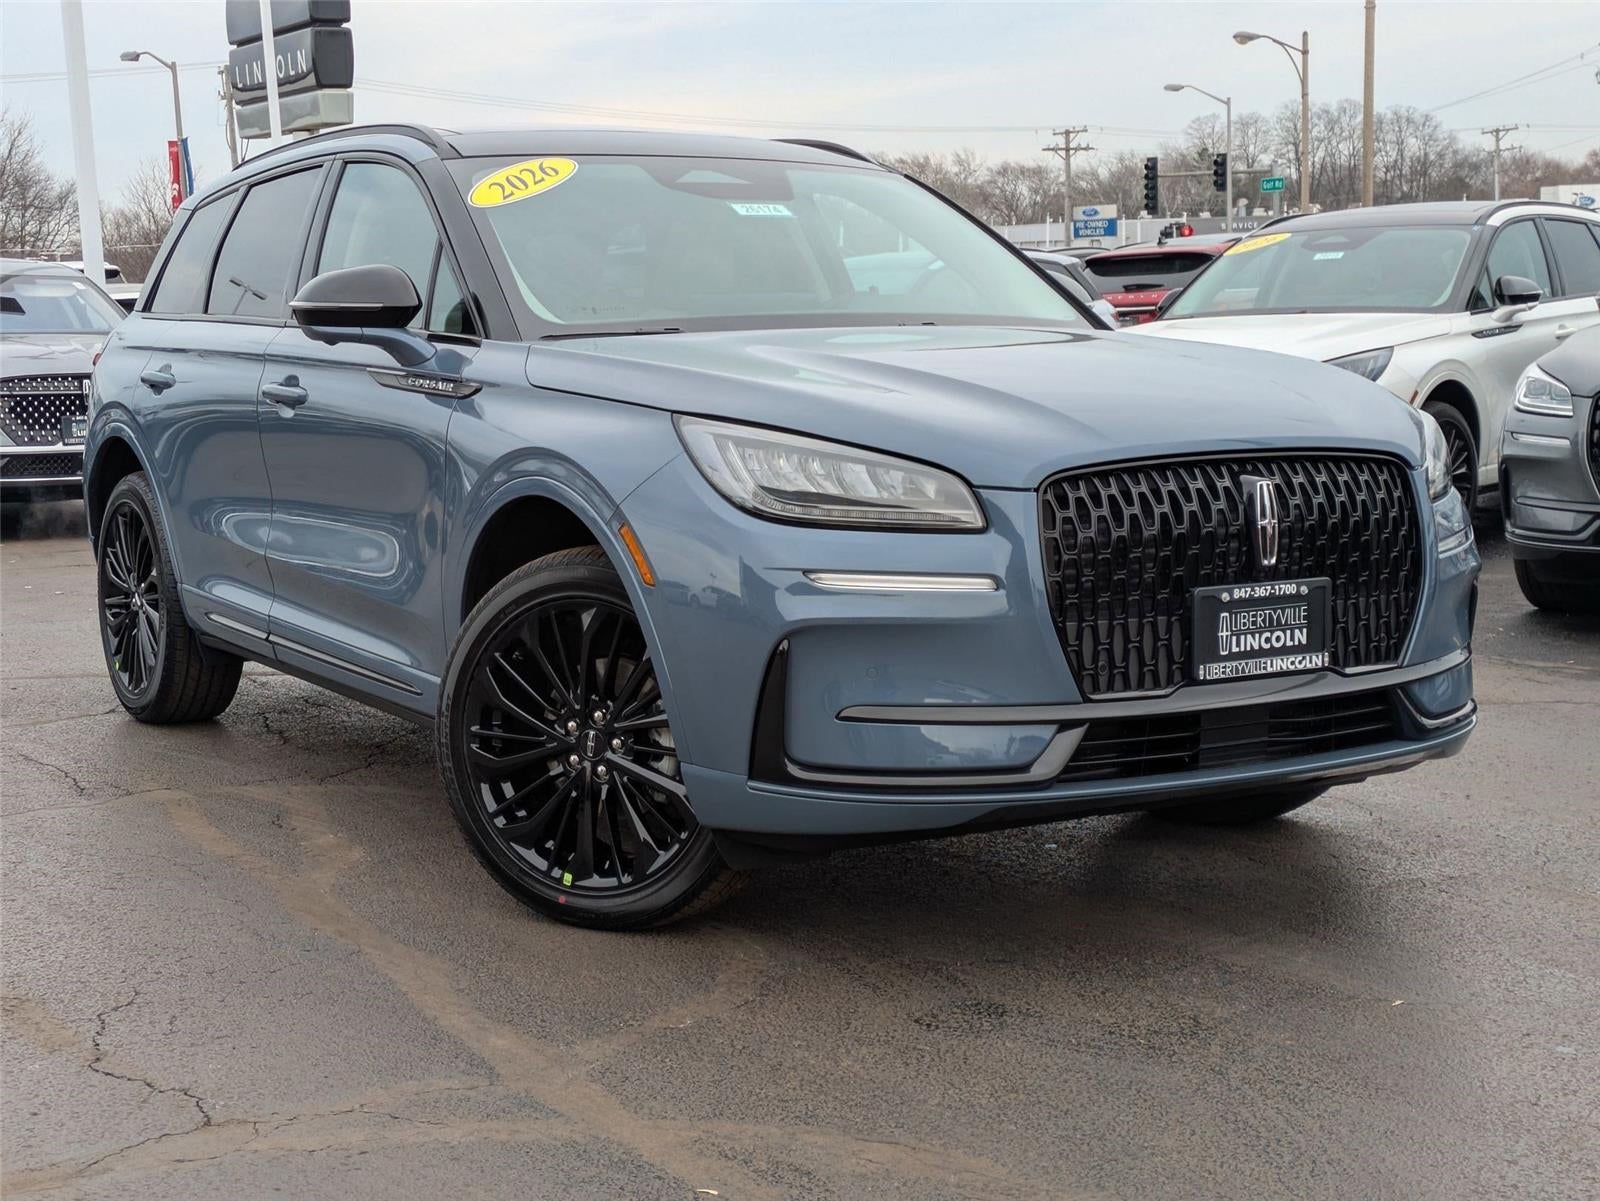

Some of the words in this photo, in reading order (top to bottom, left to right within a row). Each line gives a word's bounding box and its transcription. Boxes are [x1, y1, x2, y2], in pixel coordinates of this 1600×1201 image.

[235, 48, 307, 88] LINOLN
[488, 161, 560, 201] 2026
[1221, 222, 1258, 231] SRVICE
[407, 377, 454, 392] CORSAIR
[1233, 584, 1297, 599] 847-367-1700
[1232, 606, 1308, 631] LIBERTYVILLE
[1231, 628, 1307, 653] LINCOLN
